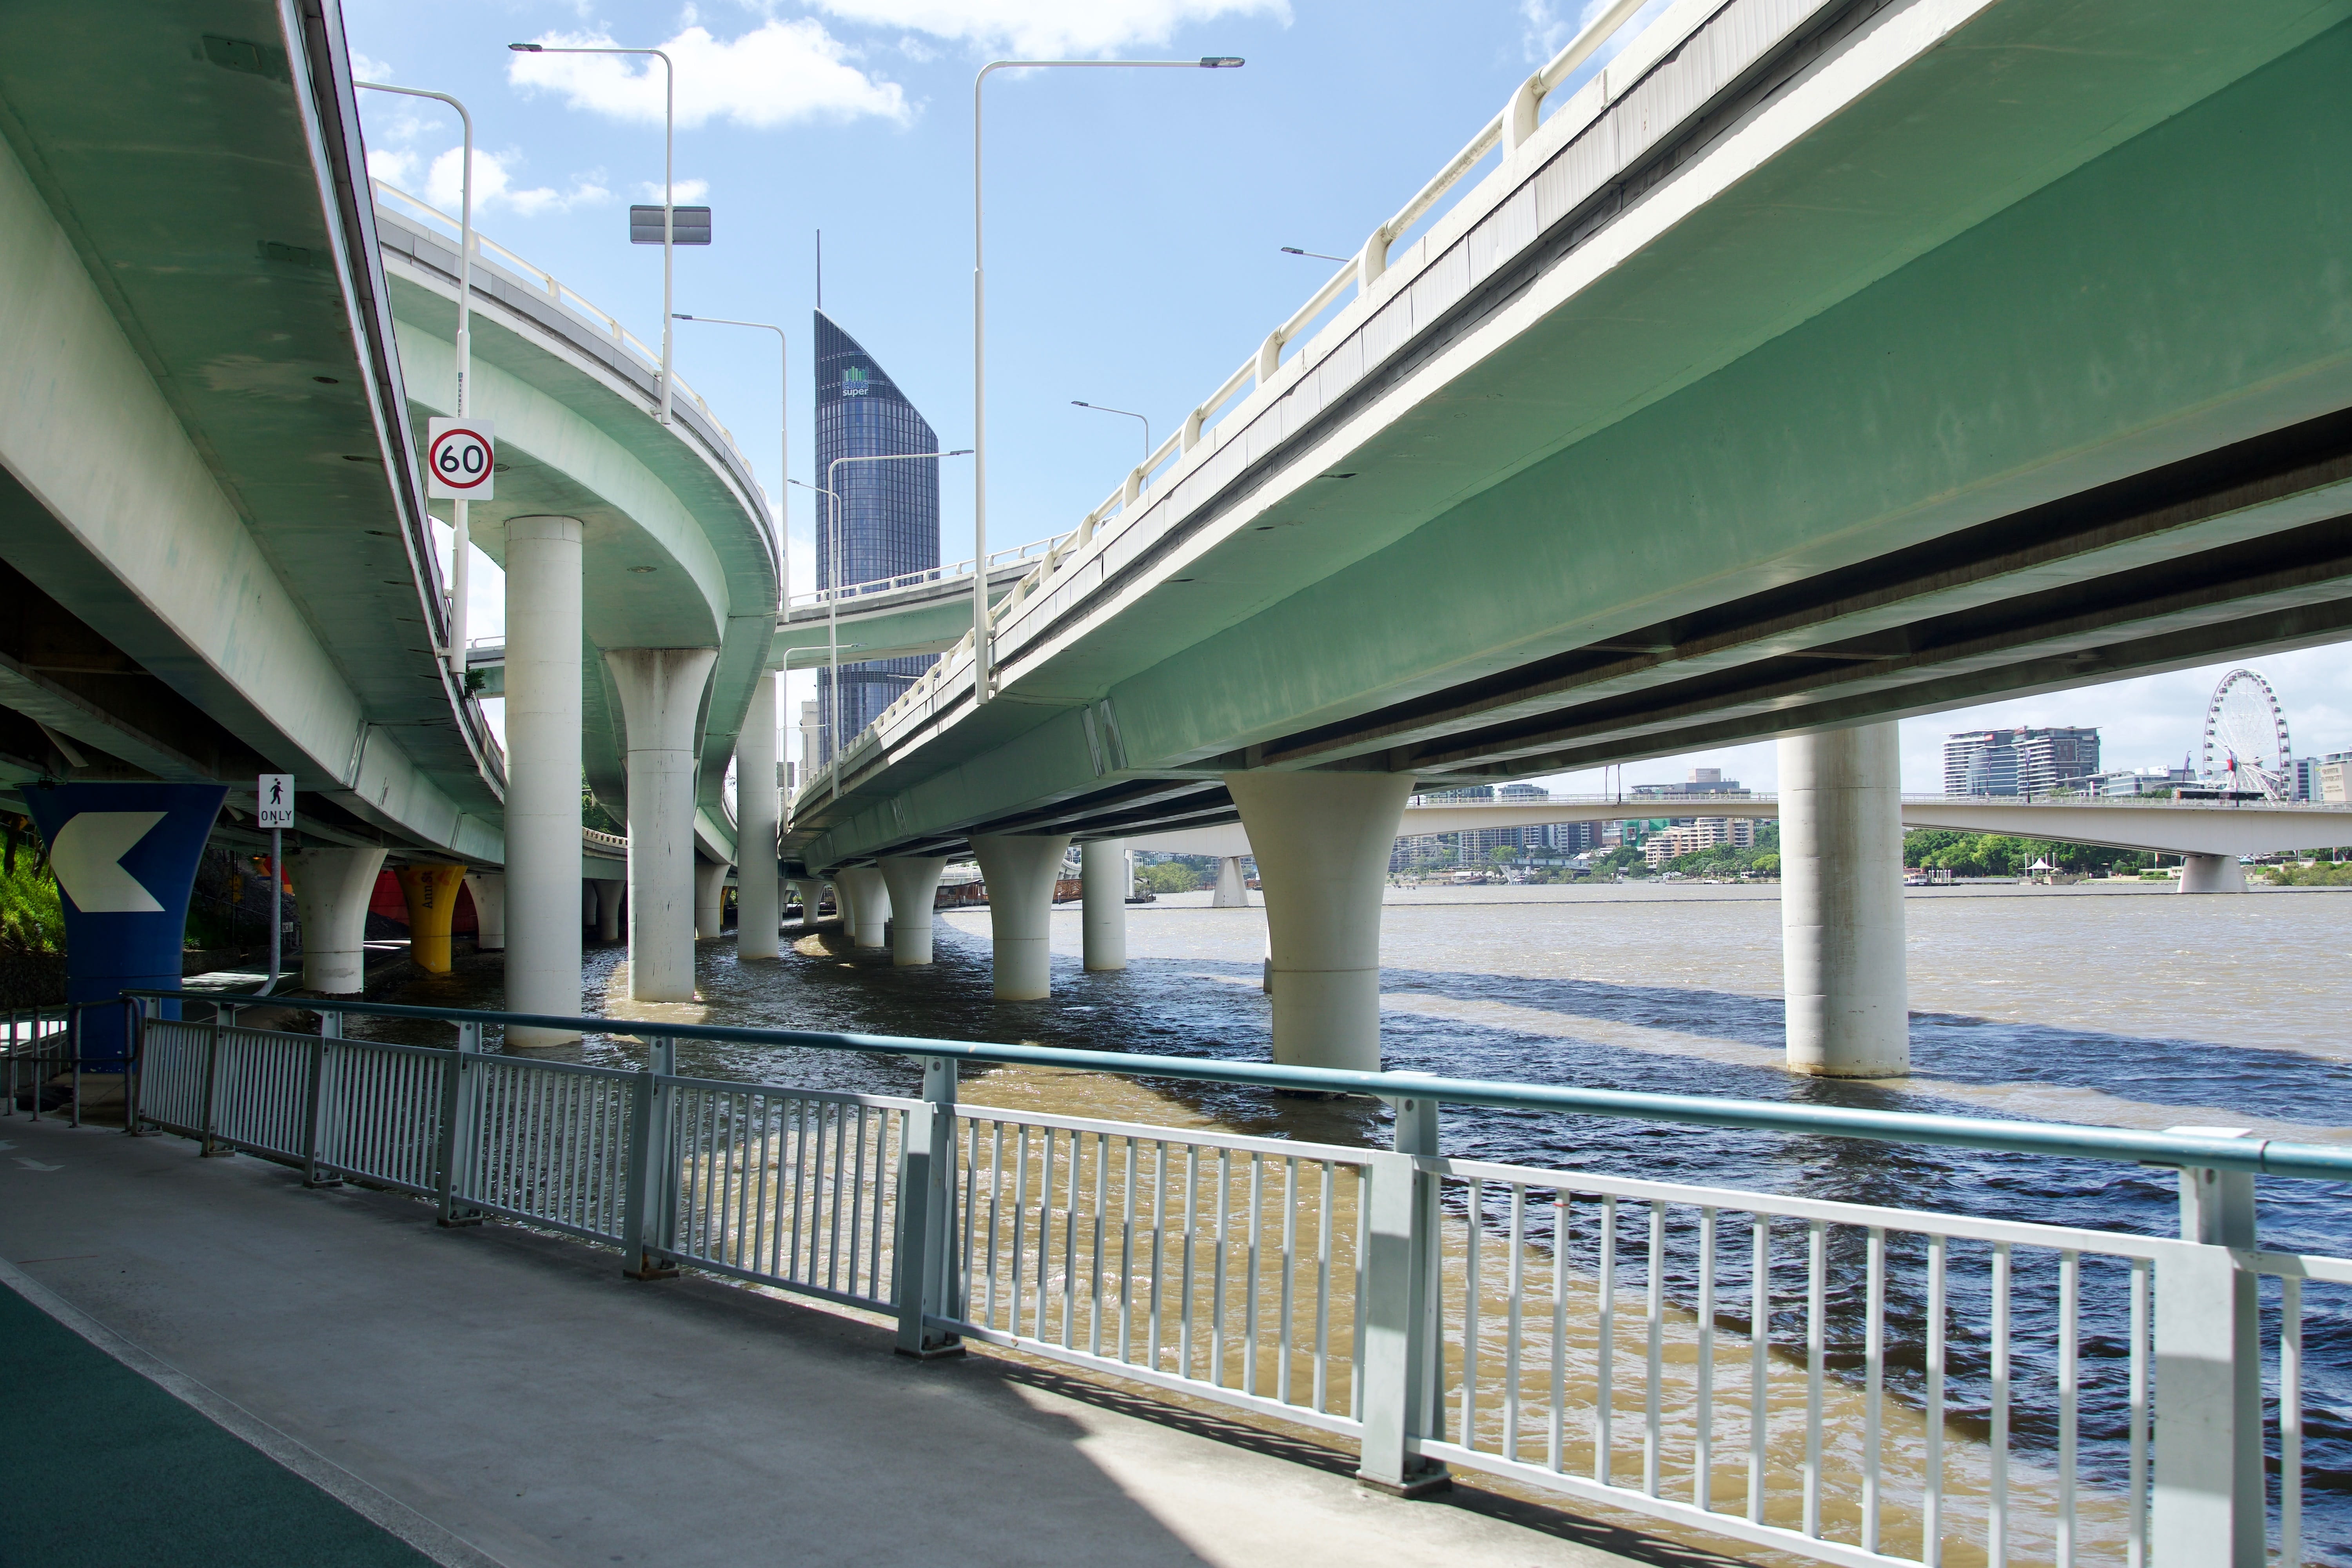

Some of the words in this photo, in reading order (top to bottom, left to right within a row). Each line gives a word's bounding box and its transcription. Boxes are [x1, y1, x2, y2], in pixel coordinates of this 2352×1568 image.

[842, 379, 869, 390] cbus
[842, 388, 869, 397] super
[440, 445, 484, 474] 60
[261, 810, 292, 821] ONLY
[421, 871, 433, 883] St
[421, 884, 433, 909] Ann
